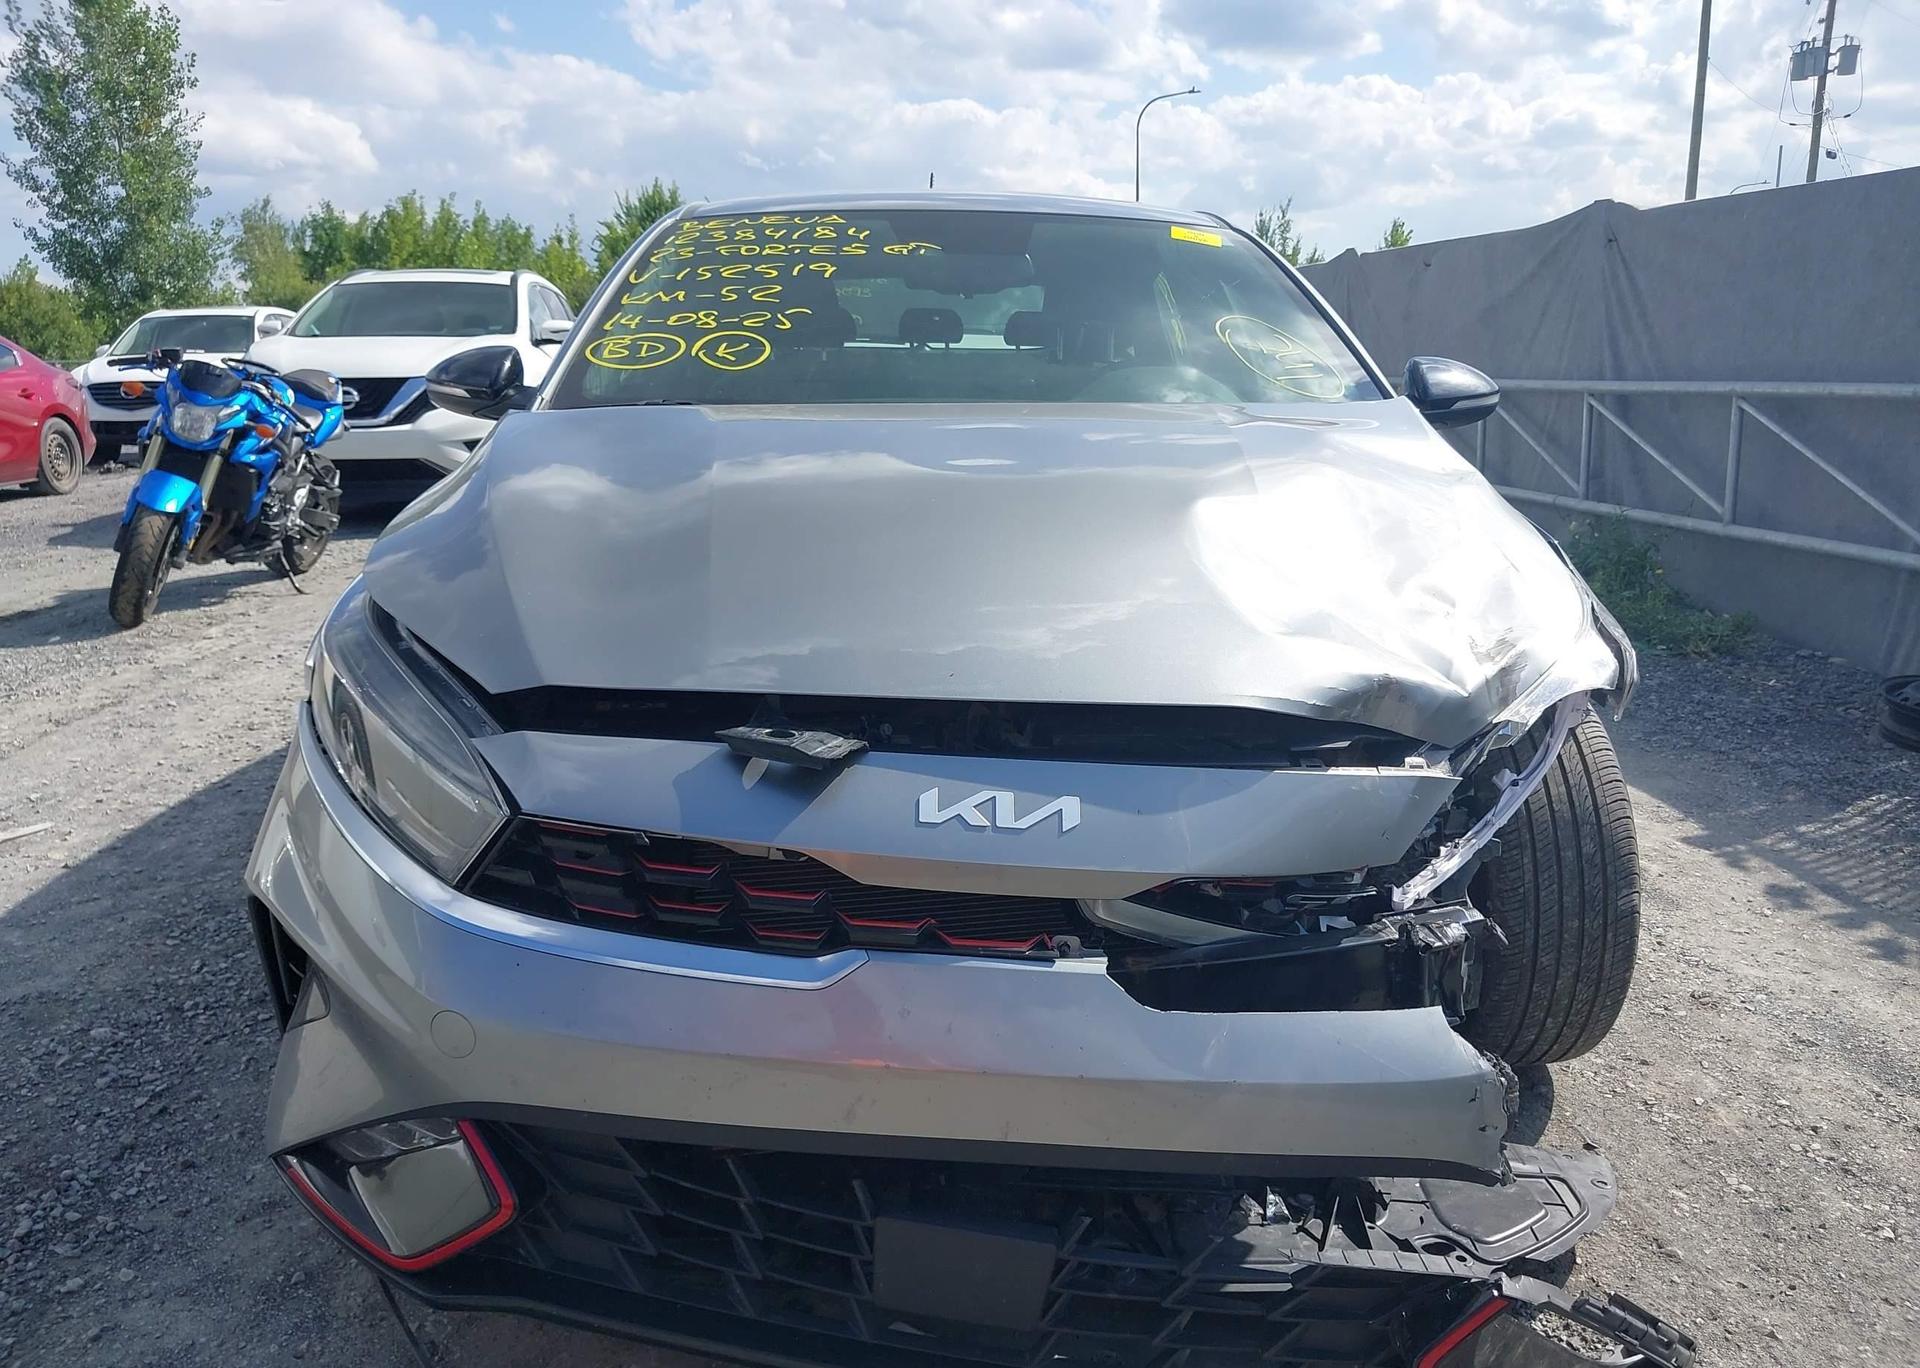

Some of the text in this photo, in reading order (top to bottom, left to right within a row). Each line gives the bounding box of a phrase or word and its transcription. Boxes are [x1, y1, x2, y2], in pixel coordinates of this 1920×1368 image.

[603, 308, 813, 331] 14-08-25
[602, 338, 750, 361] BD K
[919, 787, 1081, 832] KIA
